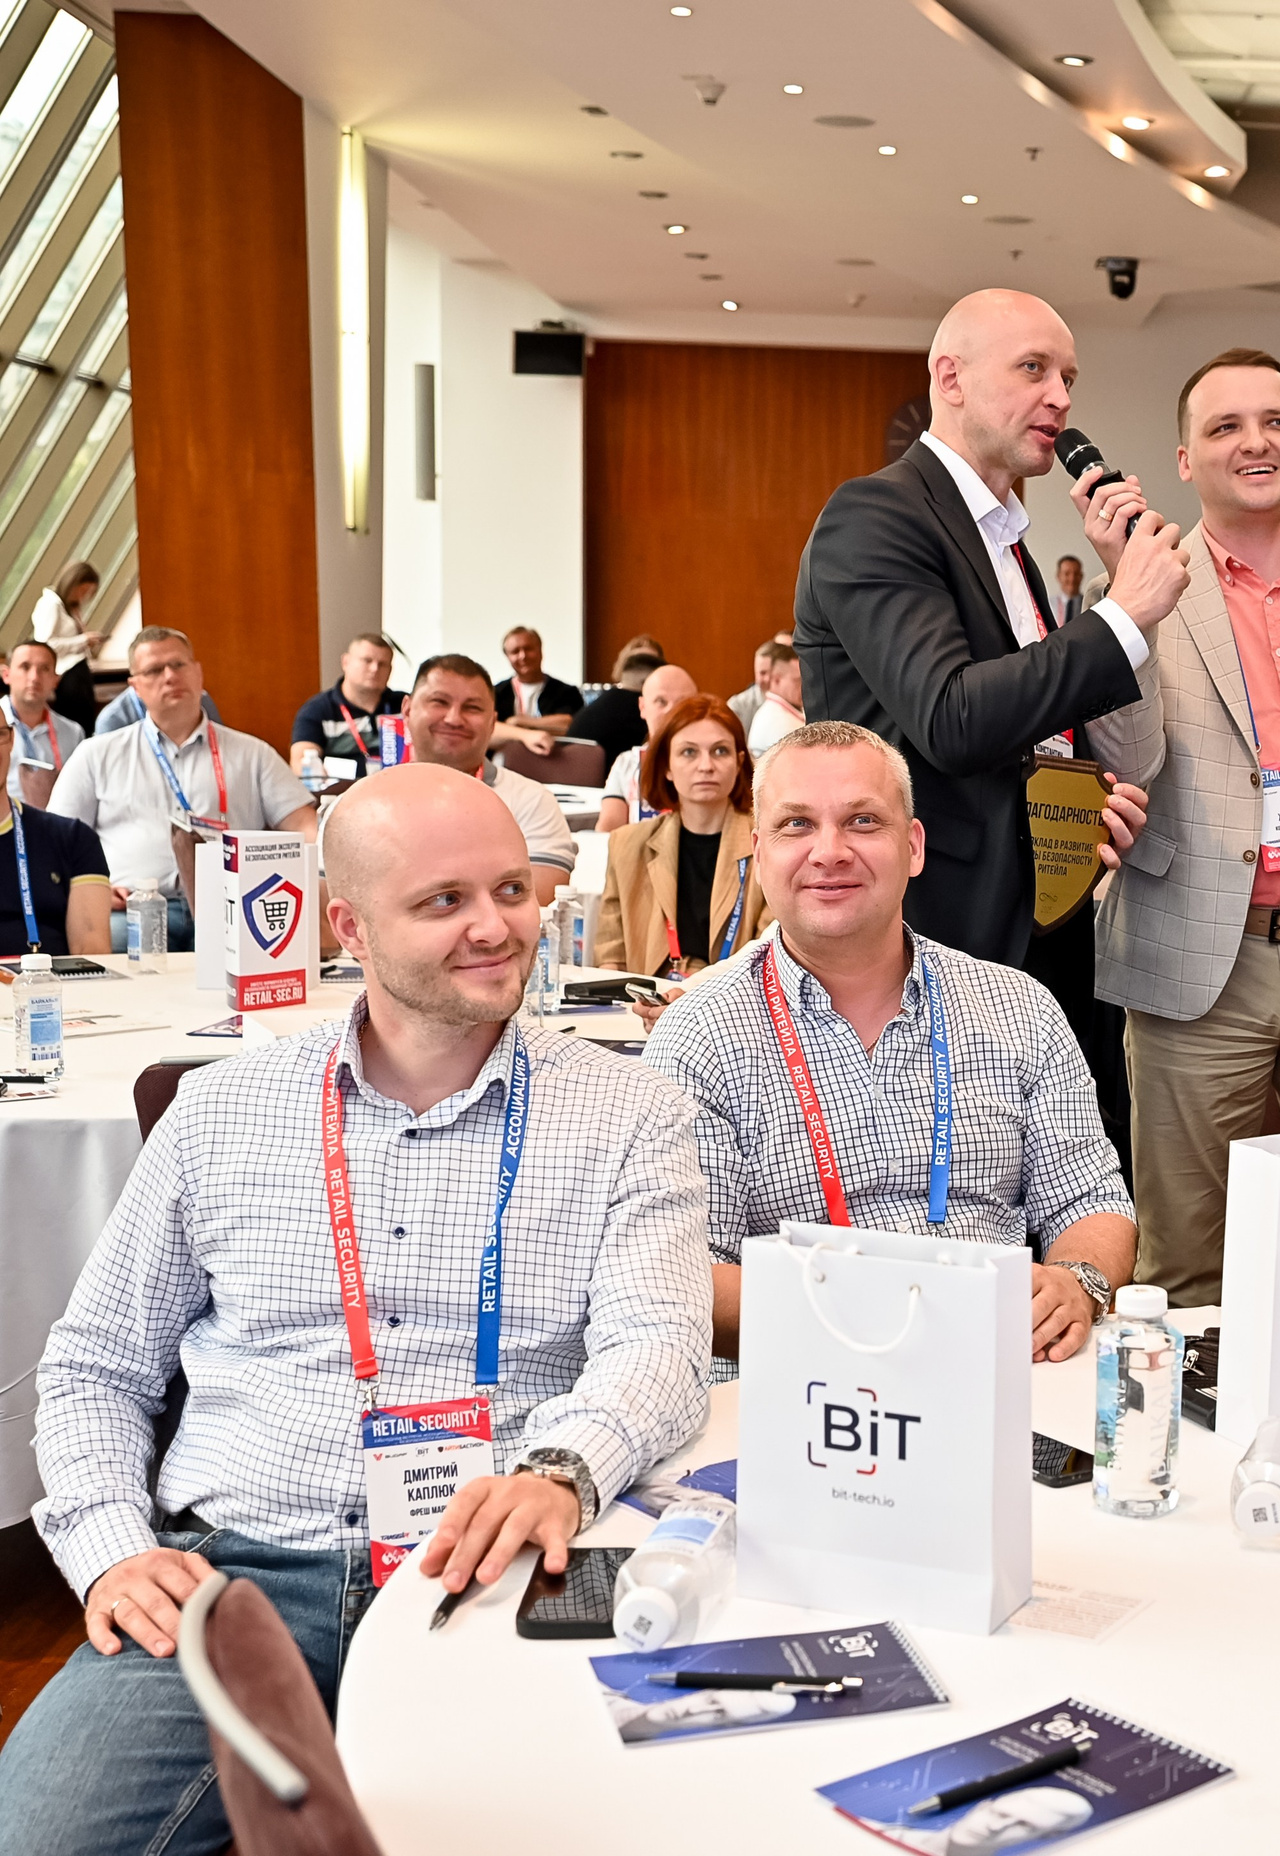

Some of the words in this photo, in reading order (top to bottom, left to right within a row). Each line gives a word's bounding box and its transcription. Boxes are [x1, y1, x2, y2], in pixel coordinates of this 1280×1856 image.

[1027, 801, 1105, 827] ЛАГОДАРНОСТЬ
[1042, 851, 1093, 866] БЕЗОПАСНОСТИ
[1054, 840, 1059, 849] В
[1060, 841, 1093, 854] РАЗВИТИЕ
[1038, 863, 1068, 876] РИТЕЙЛА
[770, 996, 796, 1057] РИТЕЙЛА
[938, 1051, 949, 1115] SECURITY
[505, 1056, 527, 1159] АССОЦИАЦИЯ
[792, 1065, 811, 1110] RETAIL
[808, 1112, 834, 1179] SECURITY
[935, 1117, 949, 1166] RETAIL
[329, 1168, 348, 1225] RETAIL
[337, 1227, 361, 1309] SECURITY
[482, 1250, 497, 1313] RETAIL
[373, 1417, 417, 1438] RETAIL
[419, 1410, 479, 1432] SECURITY
[823, 1403, 921, 1461] BiT
[403, 1462, 458, 1485] ДМИТРИЙ
[407, 1483, 457, 1502] КАПЛЮК
[409, 1507, 430, 1517] ФРЕШ
[832, 1488, 895, 1509] bit-tech.io
